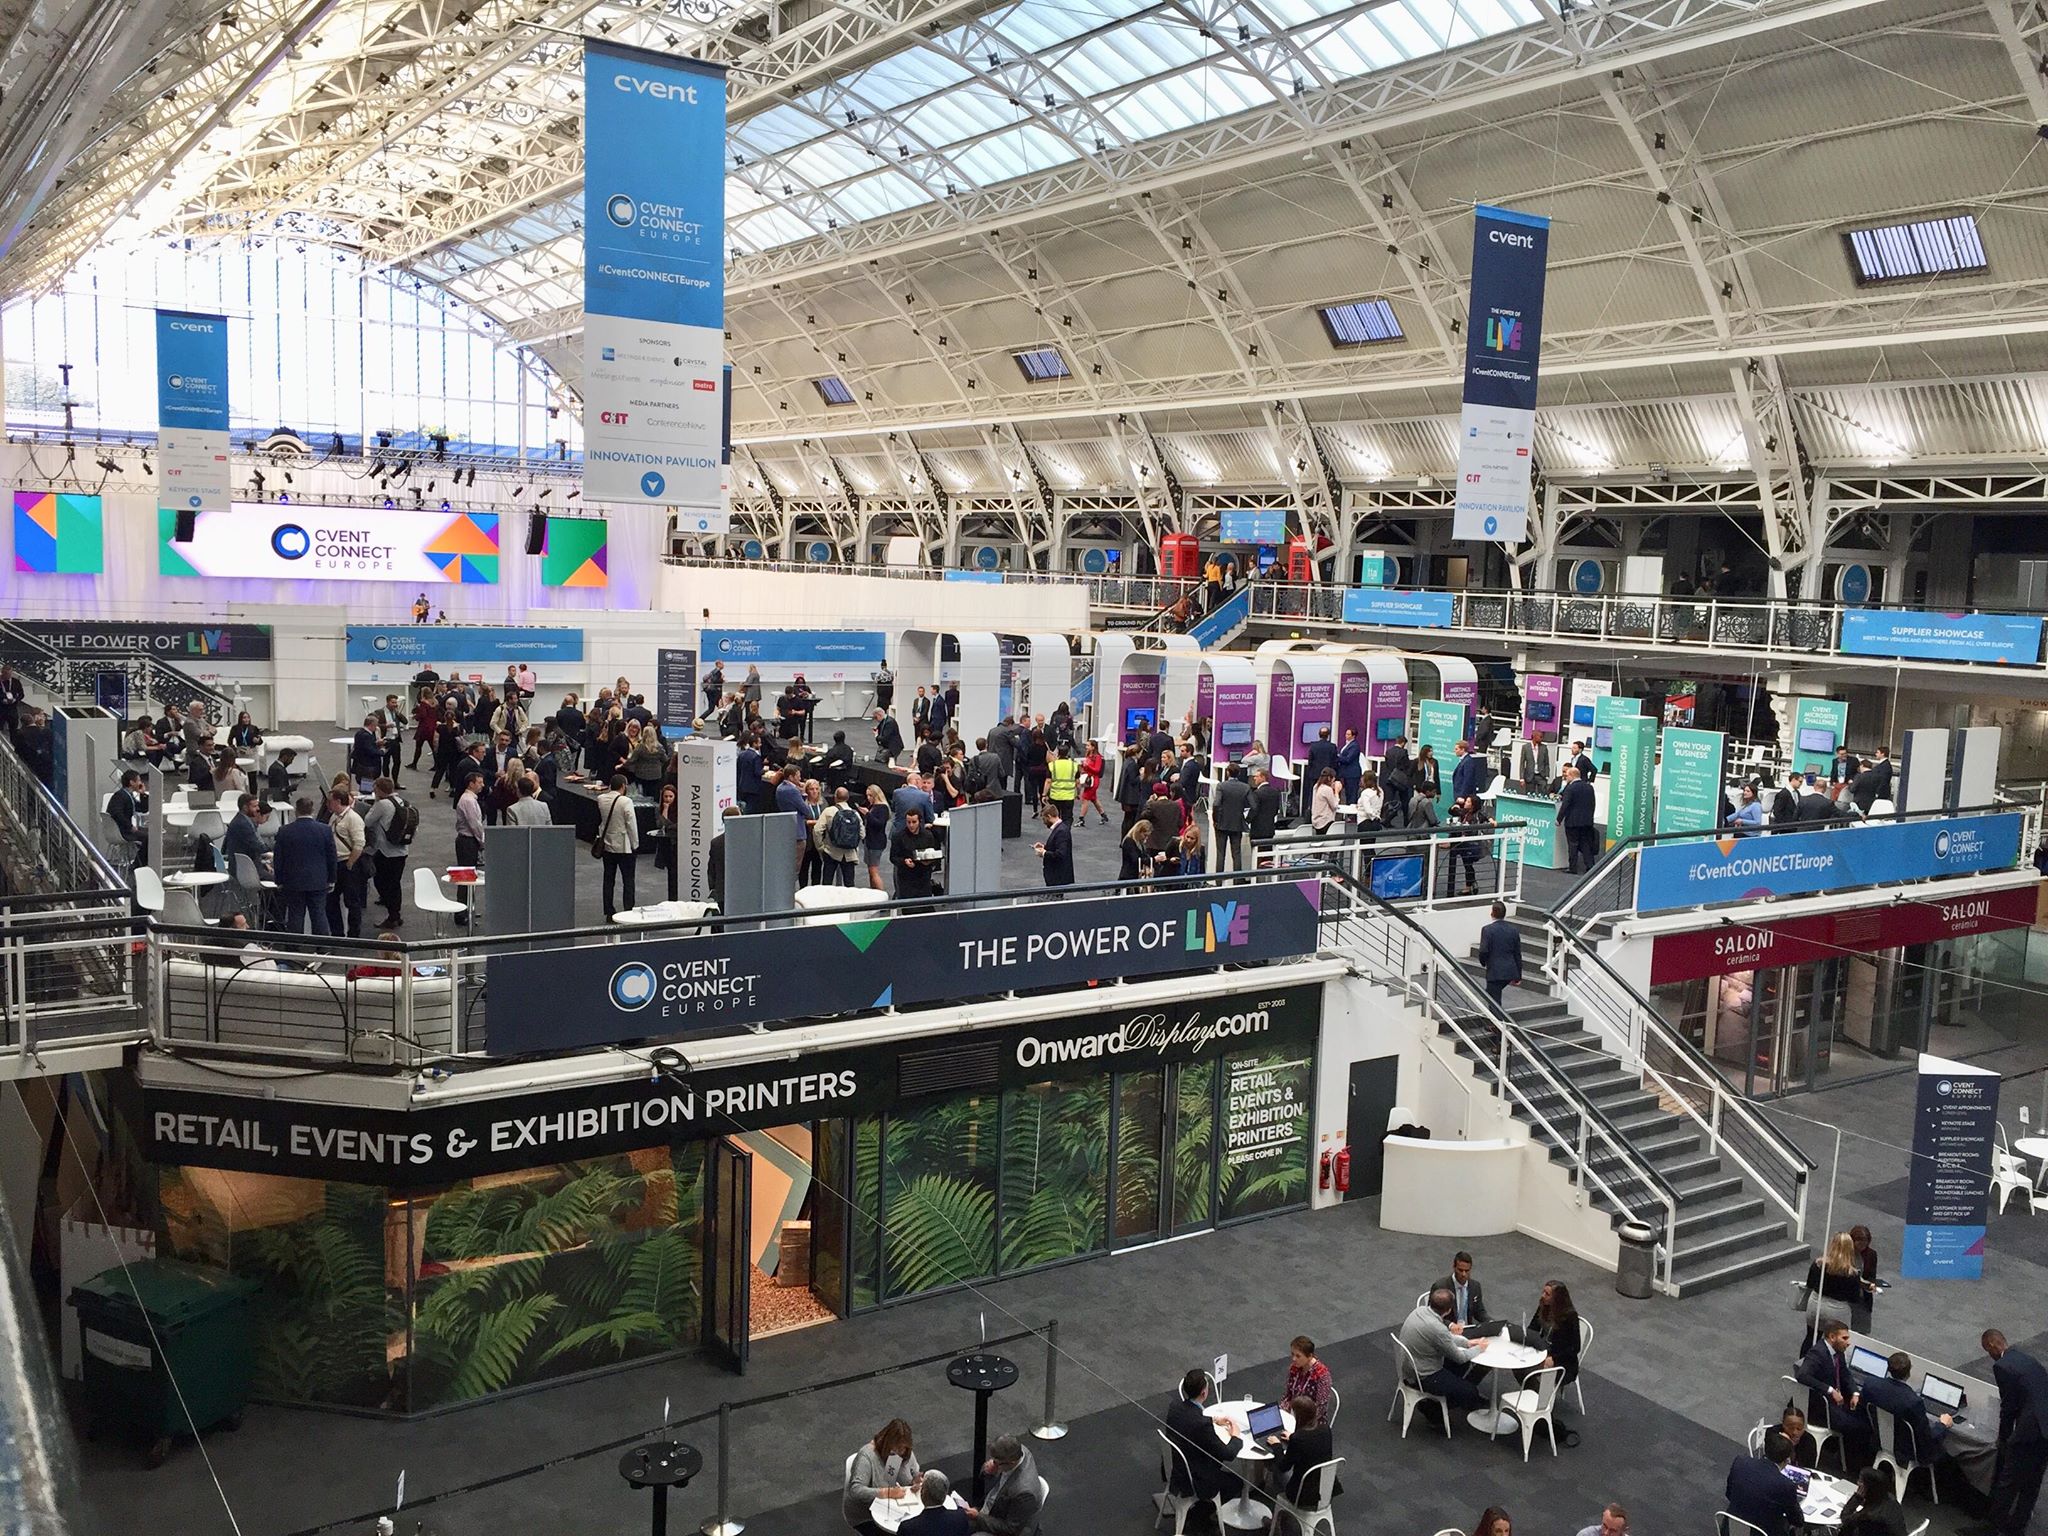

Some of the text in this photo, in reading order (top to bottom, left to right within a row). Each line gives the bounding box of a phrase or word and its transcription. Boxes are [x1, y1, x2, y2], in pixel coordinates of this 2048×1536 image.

[614, 74, 698, 105] cvent
[640, 201, 684, 219] CVENT
[640, 217, 701, 235] CONNECT
[639, 229, 701, 246] EUROPE
[1489, 230, 1534, 249] cvent
[598, 264, 711, 288] #CventCONNECTEurope
[170, 321, 214, 333] cvent
[1486, 316, 1523, 352] LIVE
[184, 376, 208, 384] CVENT
[184, 382, 218, 391] CONNECT
[650, 401, 680, 410] PARTNERS
[600, 411, 629, 425] C&IT
[589, 450, 716, 469] INNOVATION PAVILION
[1458, 502, 1525, 513] INNOVATION PAVILION
[315, 529, 371, 543] CVENT
[315, 544, 392, 559] CONNECT
[315, 559, 393, 570] EUROPE
[1891, 626, 1984, 640] SUPPLIER SHOWCASE
[38, 629, 232, 656] THE POWER OF LIVE
[1429, 718, 1454, 727] BUSINESS
[1803, 711, 1839, 721] MICROSITES
[1803, 717, 1838, 727] CHALLENGE
[1672, 740, 1712, 752] OWN YOUR
[1675, 749, 1708, 760] BUSINESS
[1640, 745, 1650, 806] INNOVATION
[1615, 744, 1628, 837] HOSPITALITY CLOUD
[1501, 813, 1551, 828] HOSPITALITY
[691, 784, 701, 902] PARTNER LOUNG
[1952, 830, 1976, 842] CVENT
[1951, 841, 1984, 854] CONNECT
[1950, 852, 1983, 863] EUROPE
[1688, 853, 1834, 881] #CventCONNECTEurope
[1942, 900, 1990, 921] SALONI
[1951, 920, 1979, 931] cerámica
[959, 900, 1251, 970] THE POWER OF LIVE
[1714, 930, 1774, 955] SALONI
[1726, 953, 1760, 966] cerámica
[662, 957, 731, 981] CVENT
[662, 975, 757, 1001] CONNECT
[661, 995, 757, 1017] EUROPE
[1271, 998, 1286, 1008] 2003
[1016, 1010, 1270, 1068] OnwardDisplay.com
[1232, 1058, 1259, 1071] ON-SITE
[1230, 1071, 1277, 1094] RETAIL
[1229, 1086, 1294, 1112] EVENTS &
[154, 1069, 857, 1165] RETAIL, EVENTS & EXHIBITION PRINTERS
[1229, 1101, 1304, 1130] EXHIBITION
[1228, 1122, 1294, 1148] PRINTERS
[1227, 1147, 1283, 1166] PLEASE COME IN
